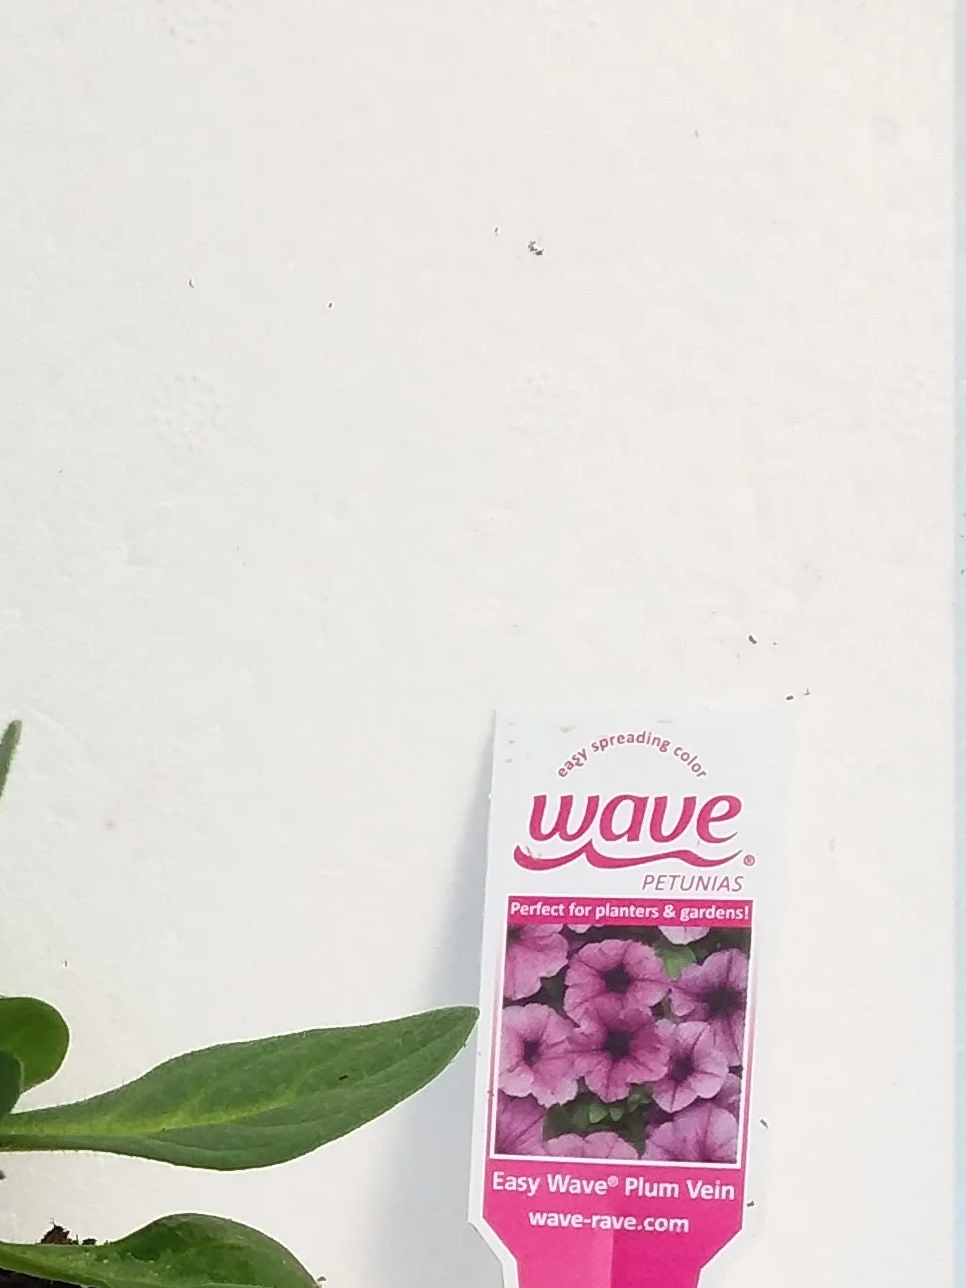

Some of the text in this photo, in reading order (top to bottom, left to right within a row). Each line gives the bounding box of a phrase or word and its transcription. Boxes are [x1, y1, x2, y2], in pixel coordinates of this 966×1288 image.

[557, 731, 707, 778] easy spreading color
[529, 794, 742, 843] wave
[642, 875, 744, 892] PETUNIAS
[510, 902, 750, 922] Perfect for planters & gardens!
[492, 1172, 540, 1194] Easy
[625, 1178, 680, 1198] Plum
[686, 1180, 736, 1200] Vein
[529, 1211, 690, 1233] wave-rave.com
